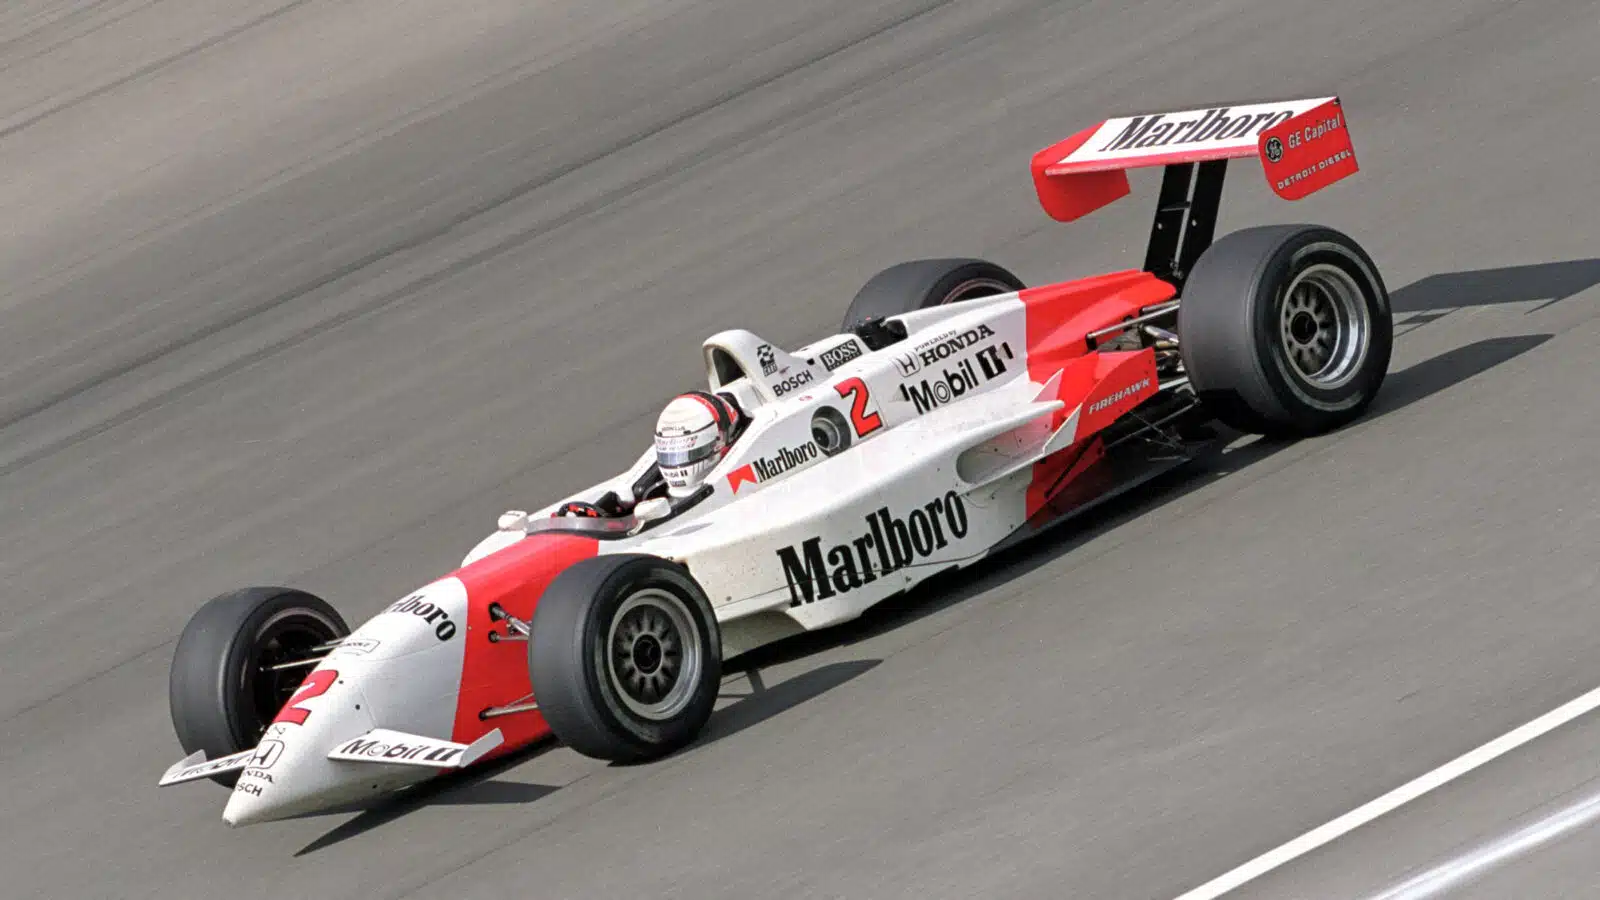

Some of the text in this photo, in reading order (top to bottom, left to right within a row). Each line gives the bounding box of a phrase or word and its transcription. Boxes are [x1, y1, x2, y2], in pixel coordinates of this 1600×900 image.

[1288, 113, 1341, 149] GE Capital
[1277, 149, 1352, 189] DETROIT DIESEL
[822, 340, 858, 367] BOSS
[919, 324, 995, 367] HONDA
[772, 369, 814, 397] BOSCH
[908, 358, 979, 415] Mobil
[1088, 377, 1151, 415] FIREHAWK
[833, 376, 883, 439] 2
[752, 440, 818, 483] Marlboro
[776, 490, 968, 608] Marlboro
[272, 669, 339, 726] 2
[341, 739, 428, 760] Mobil
[236, 782, 263, 797] SCH
